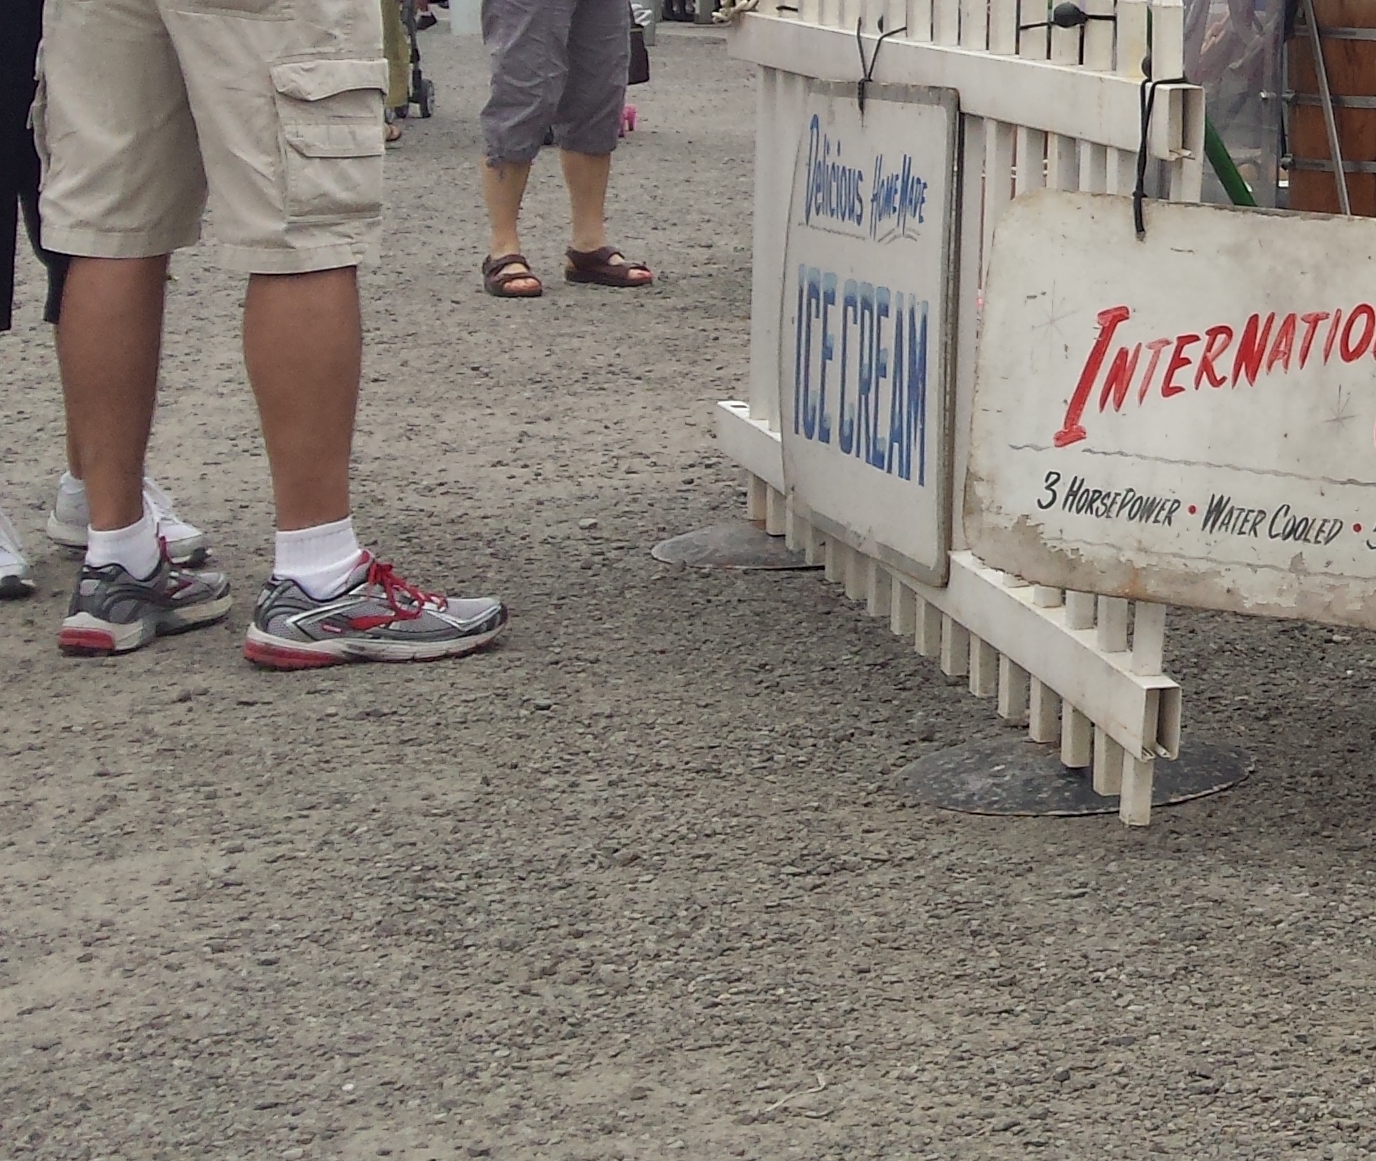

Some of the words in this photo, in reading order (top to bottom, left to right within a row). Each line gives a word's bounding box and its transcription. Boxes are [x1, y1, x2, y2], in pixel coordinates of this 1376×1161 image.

[805, 114, 863, 226] Delicious
[794, 263, 837, 444] ICE
[838, 279, 928, 487] CREAM
[1037, 471, 1061, 510] 3
[1201, 494, 1265, 539] WATER
[1268, 503, 1344, 546] COOLED
